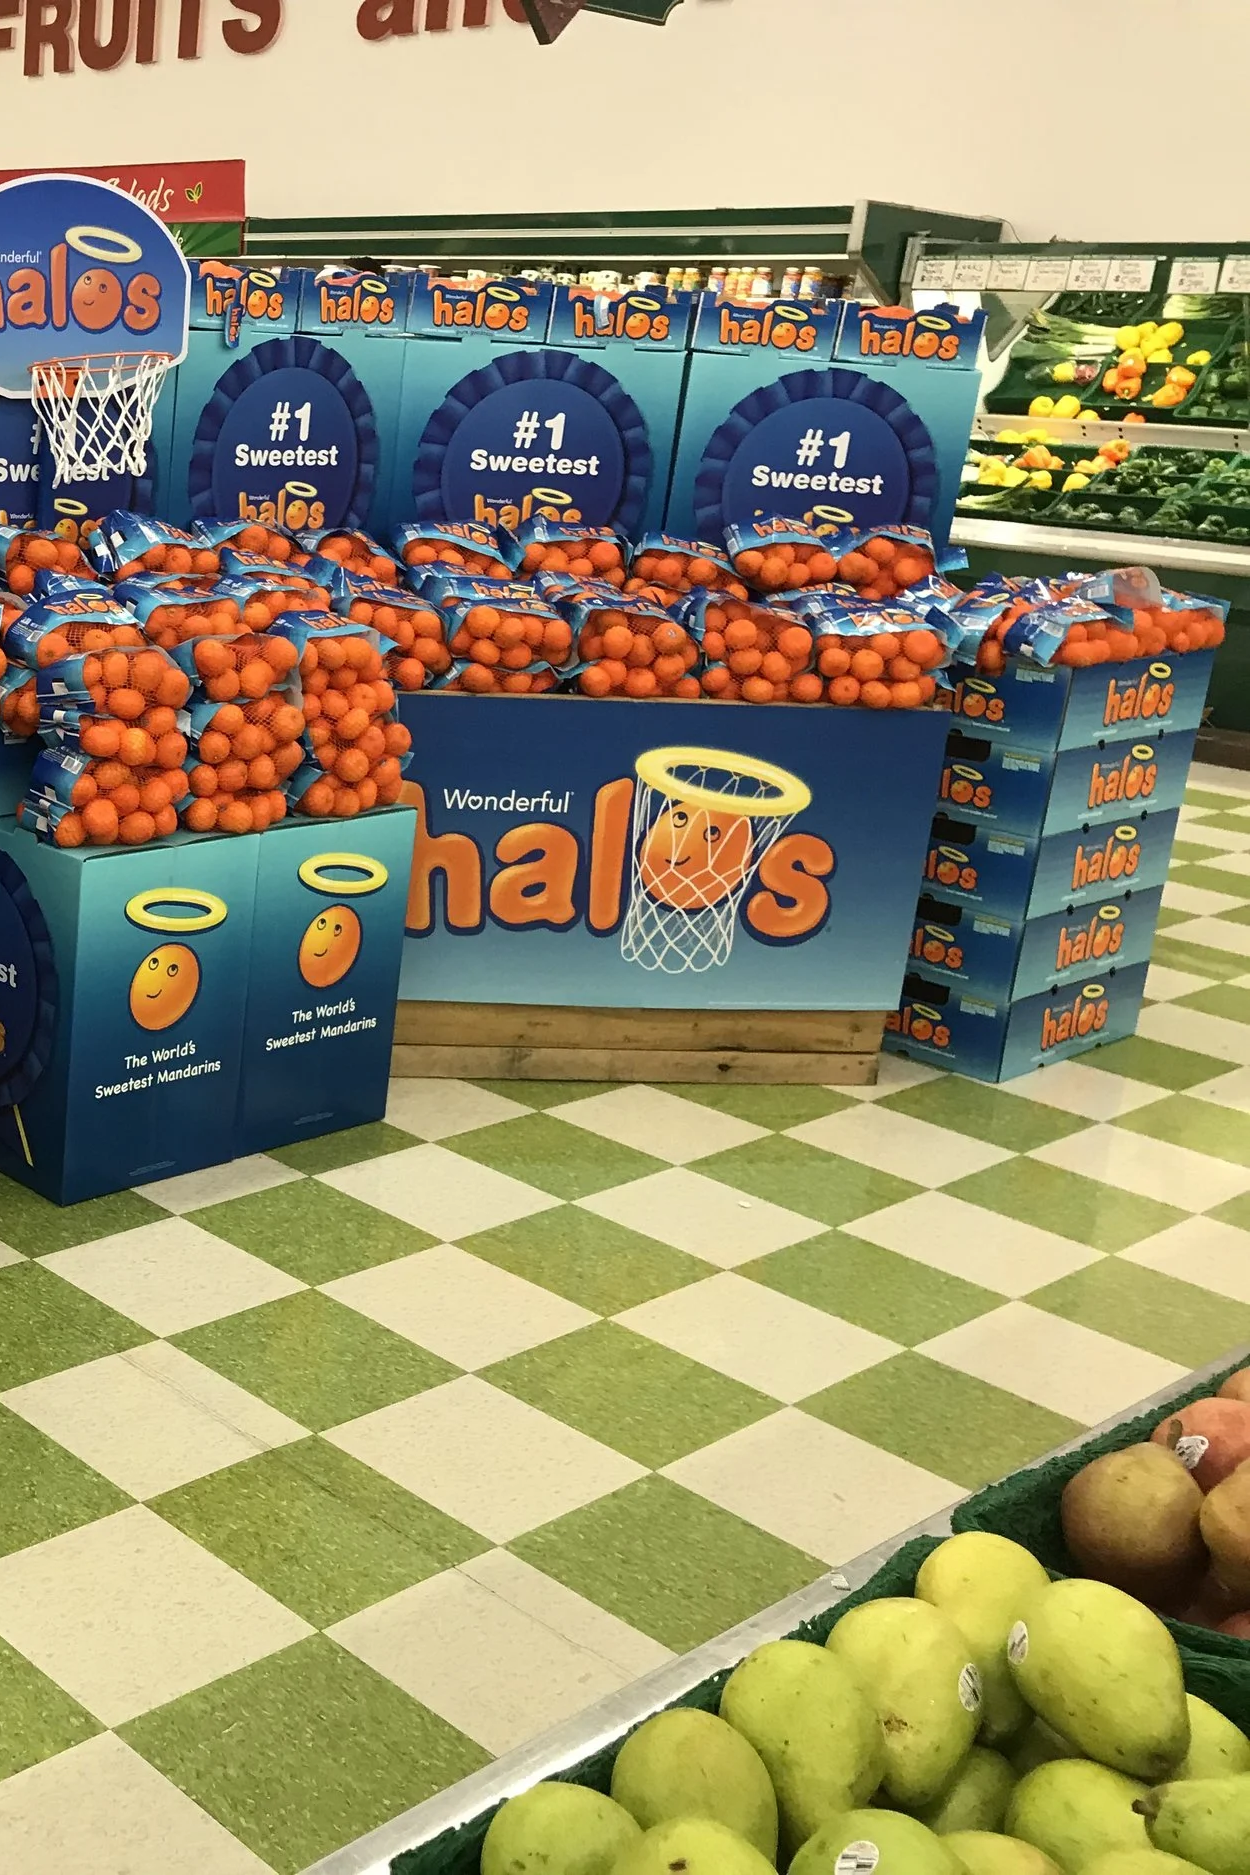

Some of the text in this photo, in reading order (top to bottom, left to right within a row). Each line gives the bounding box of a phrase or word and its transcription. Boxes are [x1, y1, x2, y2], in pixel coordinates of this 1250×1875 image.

[320, 285, 394, 323] halos
[434, 288, 529, 331] halos
[720, 308, 816, 350] halos
[861, 319, 959, 360] halos
[269, 402, 311, 441] #1
[513, 411, 566, 450] #1
[235, 444, 339, 467] Sweetest
[470, 449, 600, 476] Sweetest
[796, 428, 851, 469] #1
[751, 465, 884, 496] Sweetest
[239, 488, 325, 530] halos
[1103, 671, 1175, 727] halos
[444, 788, 570, 814] Wonderful
[1088, 754, 1158, 809] halos
[402, 778, 834, 938] halos
[1071, 836, 1141, 890] halos
[1055, 916, 1124, 971] halos
[292, 998, 356, 1024] The World's
[1041, 995, 1109, 1051] halos
[266, 1016, 377, 1051] Sweetest Mandarins
[124, 1040, 196, 1070] The World's
[94, 1060, 221, 1099] Sweetest Mandarins
